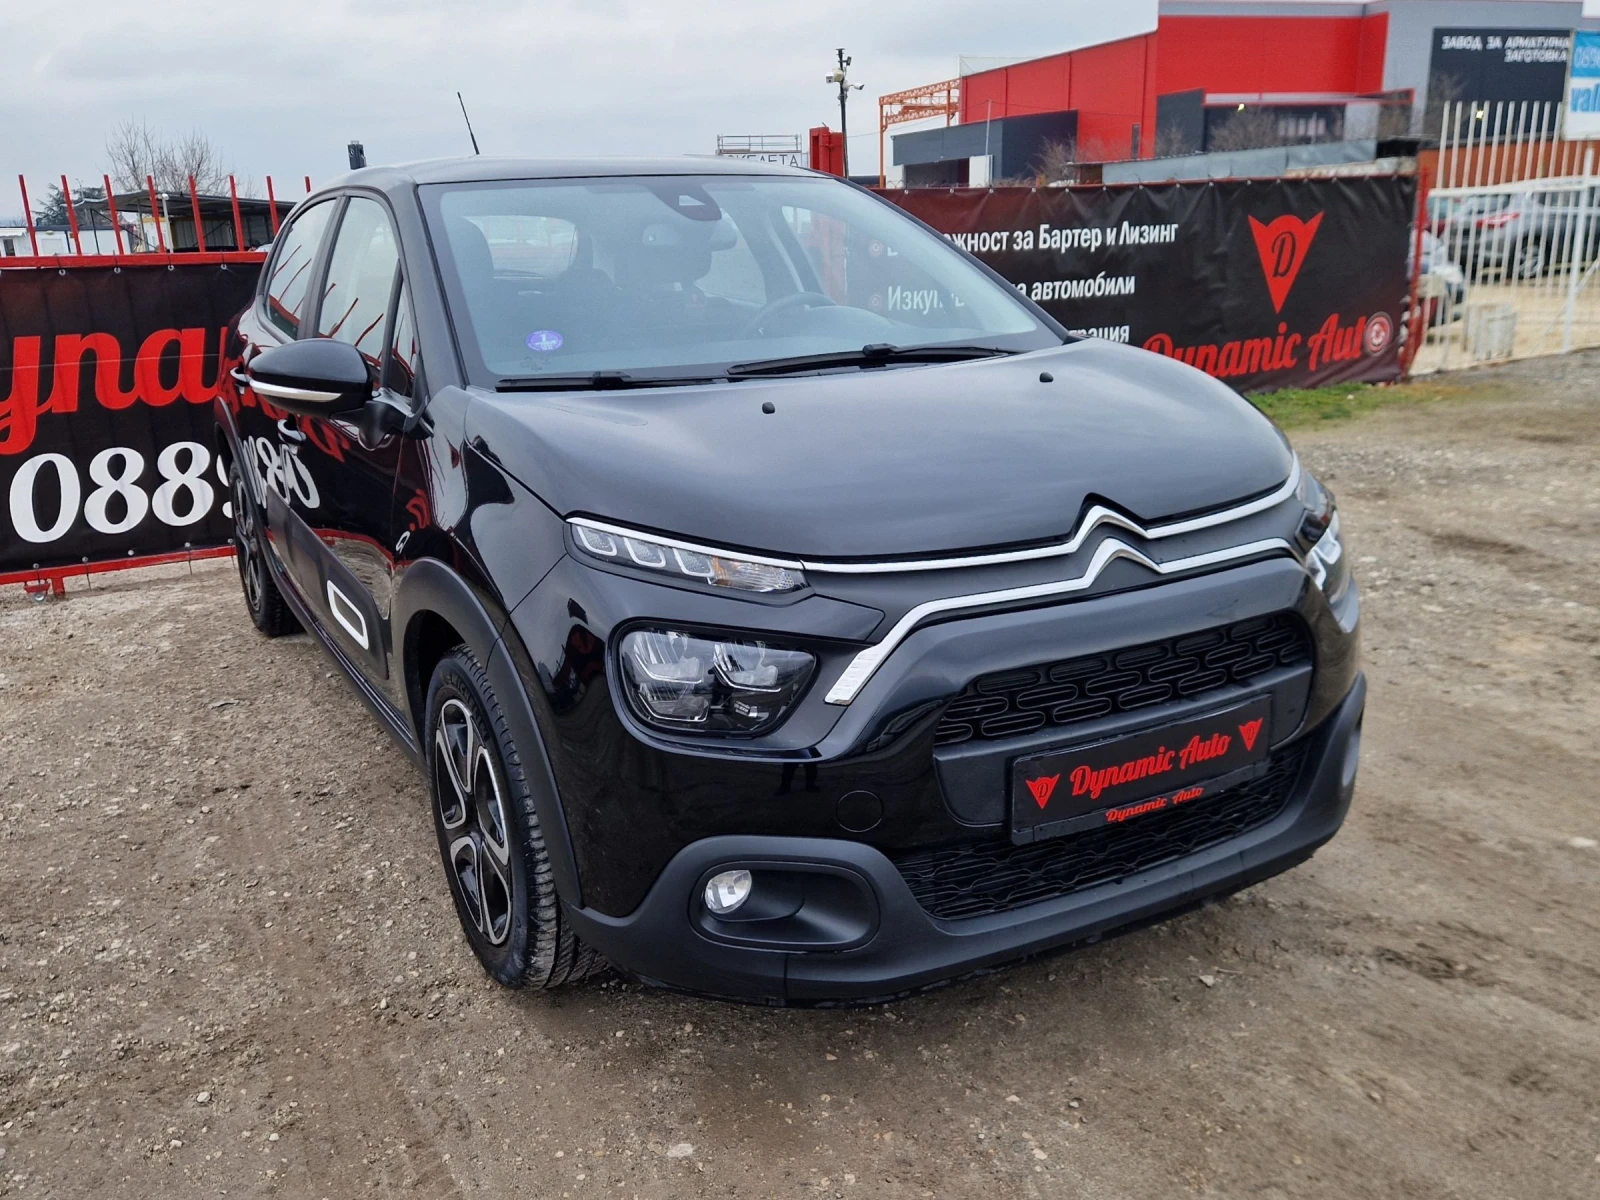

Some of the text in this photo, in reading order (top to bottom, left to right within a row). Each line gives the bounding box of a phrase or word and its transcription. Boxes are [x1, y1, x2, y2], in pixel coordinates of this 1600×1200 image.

[1441, 35, 1483, 51] ЗАВОД
[1486, 35, 1503, 49] ЗА
[1504, 49, 1567, 62] ЗАГОТОВКА
[1013, 230, 1033, 250] за
[1038, 223, 1102, 254] Бартер
[1106, 226, 1117, 246] и
[1119, 220, 1179, 246] Лизинг
[1271, 231, 1296, 278] D
[1031, 271, 1136, 301] автомобили
[0, 326, 229, 455] yna
[9, 441, 234, 543] 088
[1069, 746, 1175, 800] Dynamic
[1179, 732, 1231, 770] Auto
[1105, 787, 1204, 822] Dynamic Auto
